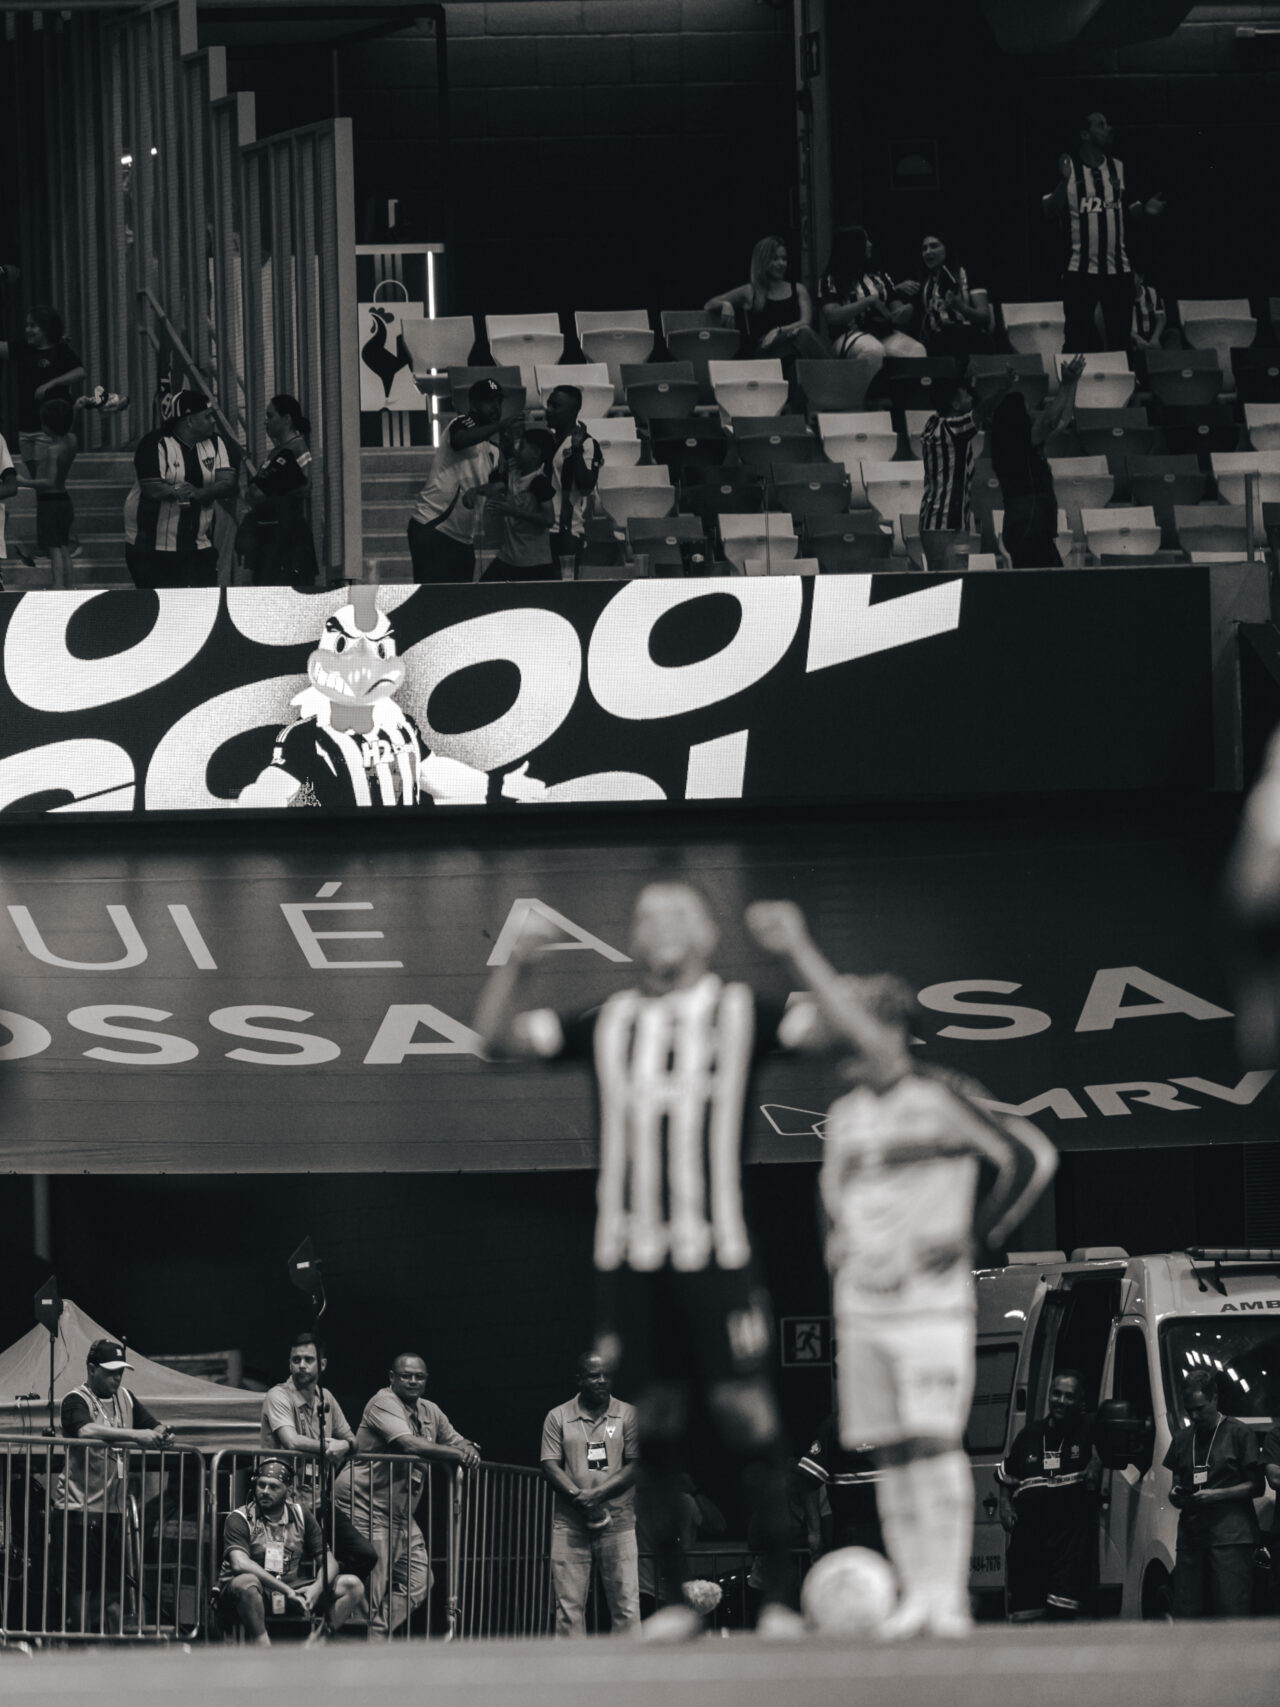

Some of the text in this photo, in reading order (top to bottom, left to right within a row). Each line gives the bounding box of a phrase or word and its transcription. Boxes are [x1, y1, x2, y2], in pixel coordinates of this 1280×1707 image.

[1080, 197, 1103, 214] H2
[279, 881, 404, 969] É
[486, 898, 633, 966] A
[972, 1069, 1278, 1120] MRV
[1220, 1300, 1280, 1313] AMB
